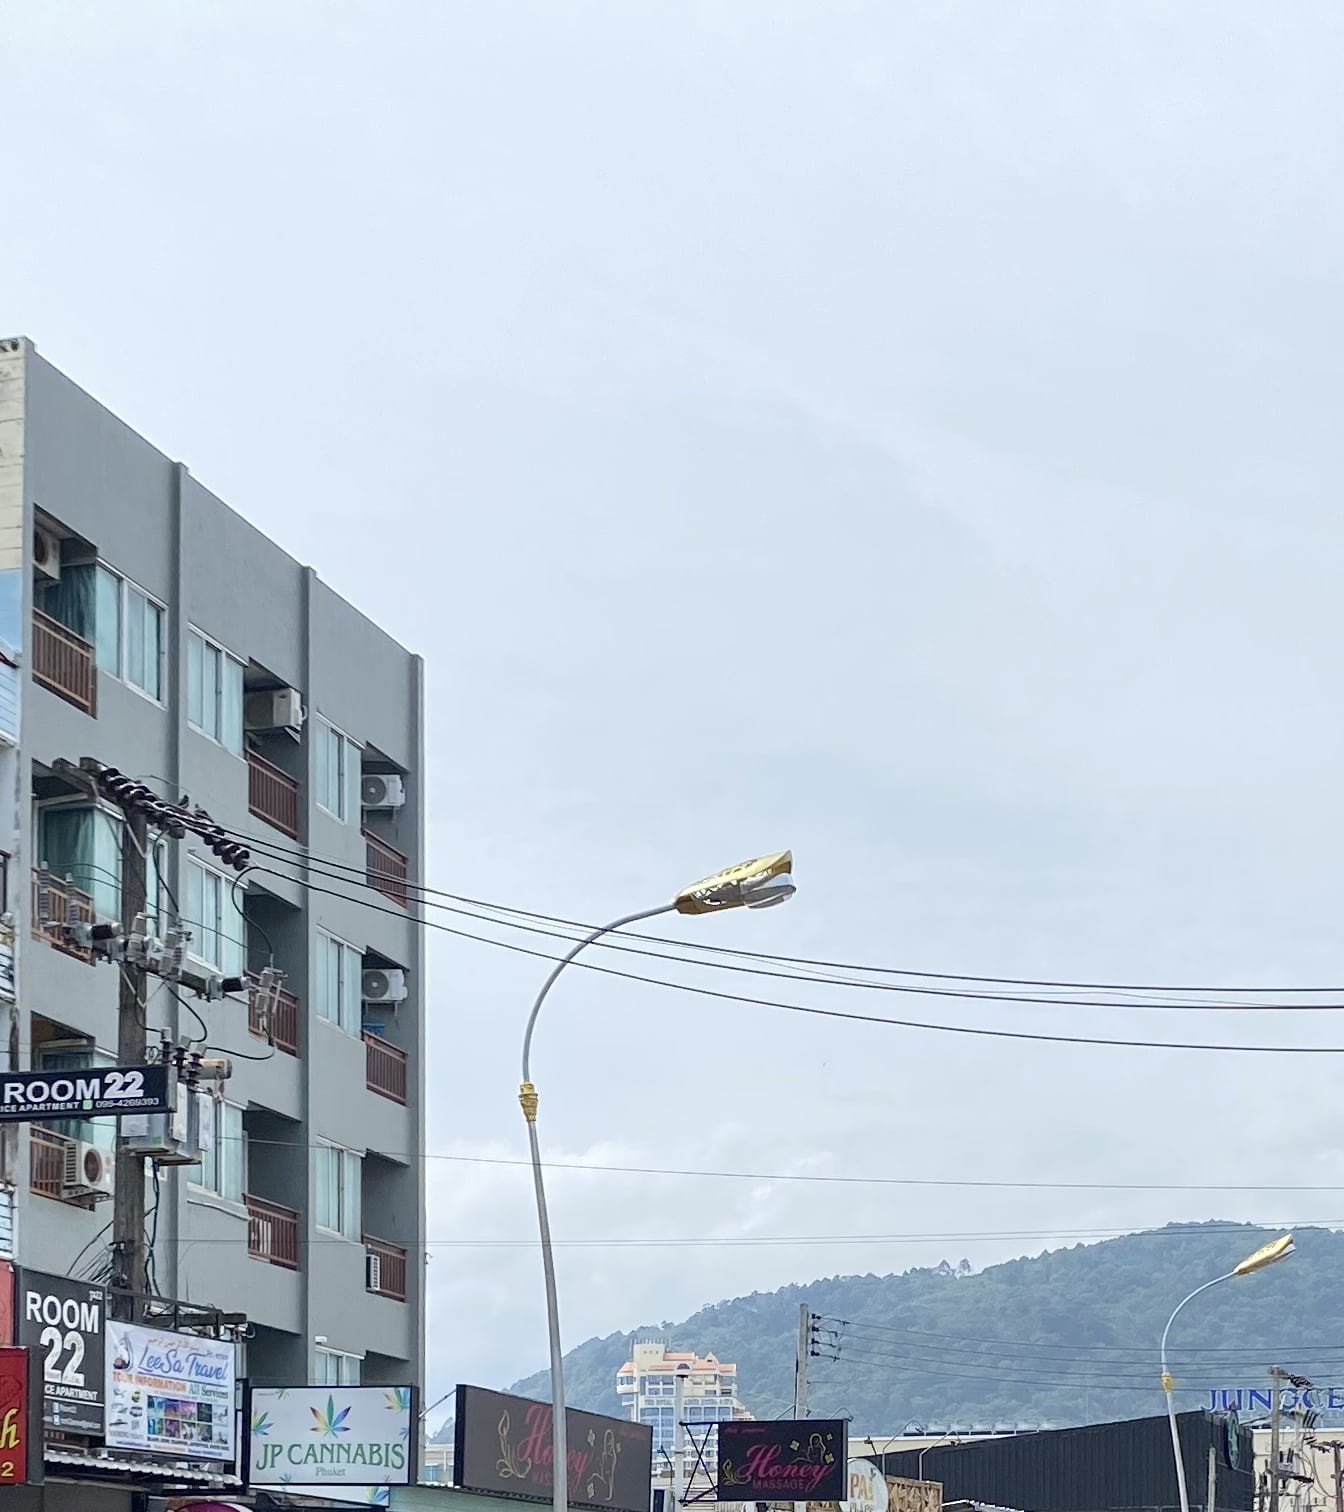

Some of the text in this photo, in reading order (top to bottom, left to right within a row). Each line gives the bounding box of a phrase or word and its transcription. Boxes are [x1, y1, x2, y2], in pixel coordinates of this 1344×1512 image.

[18, 1101, 80, 1112] APARTMENT
[26, 1291, 99, 1334] ROOM
[40, 1326, 85, 1387] 22
[138, 1343, 184, 1374] LeeSa
[185, 1352, 229, 1380] Travel
[55, 1386, 98, 1401] APARTMENT
[134, 1375, 187, 1392] INFORMATION
[188, 1383, 201, 1395] All
[256, 1442, 283, 1471] JP
[285, 1442, 406, 1470] CANNABIS
[518, 1403, 593, 1492] Hoey
[1, 1461, 14, 1478] 2
[315, 1466, 347, 1478] Phuket
[736, 1444, 836, 1493] Honey
[752, 1477, 805, 1489] MASSAGE
